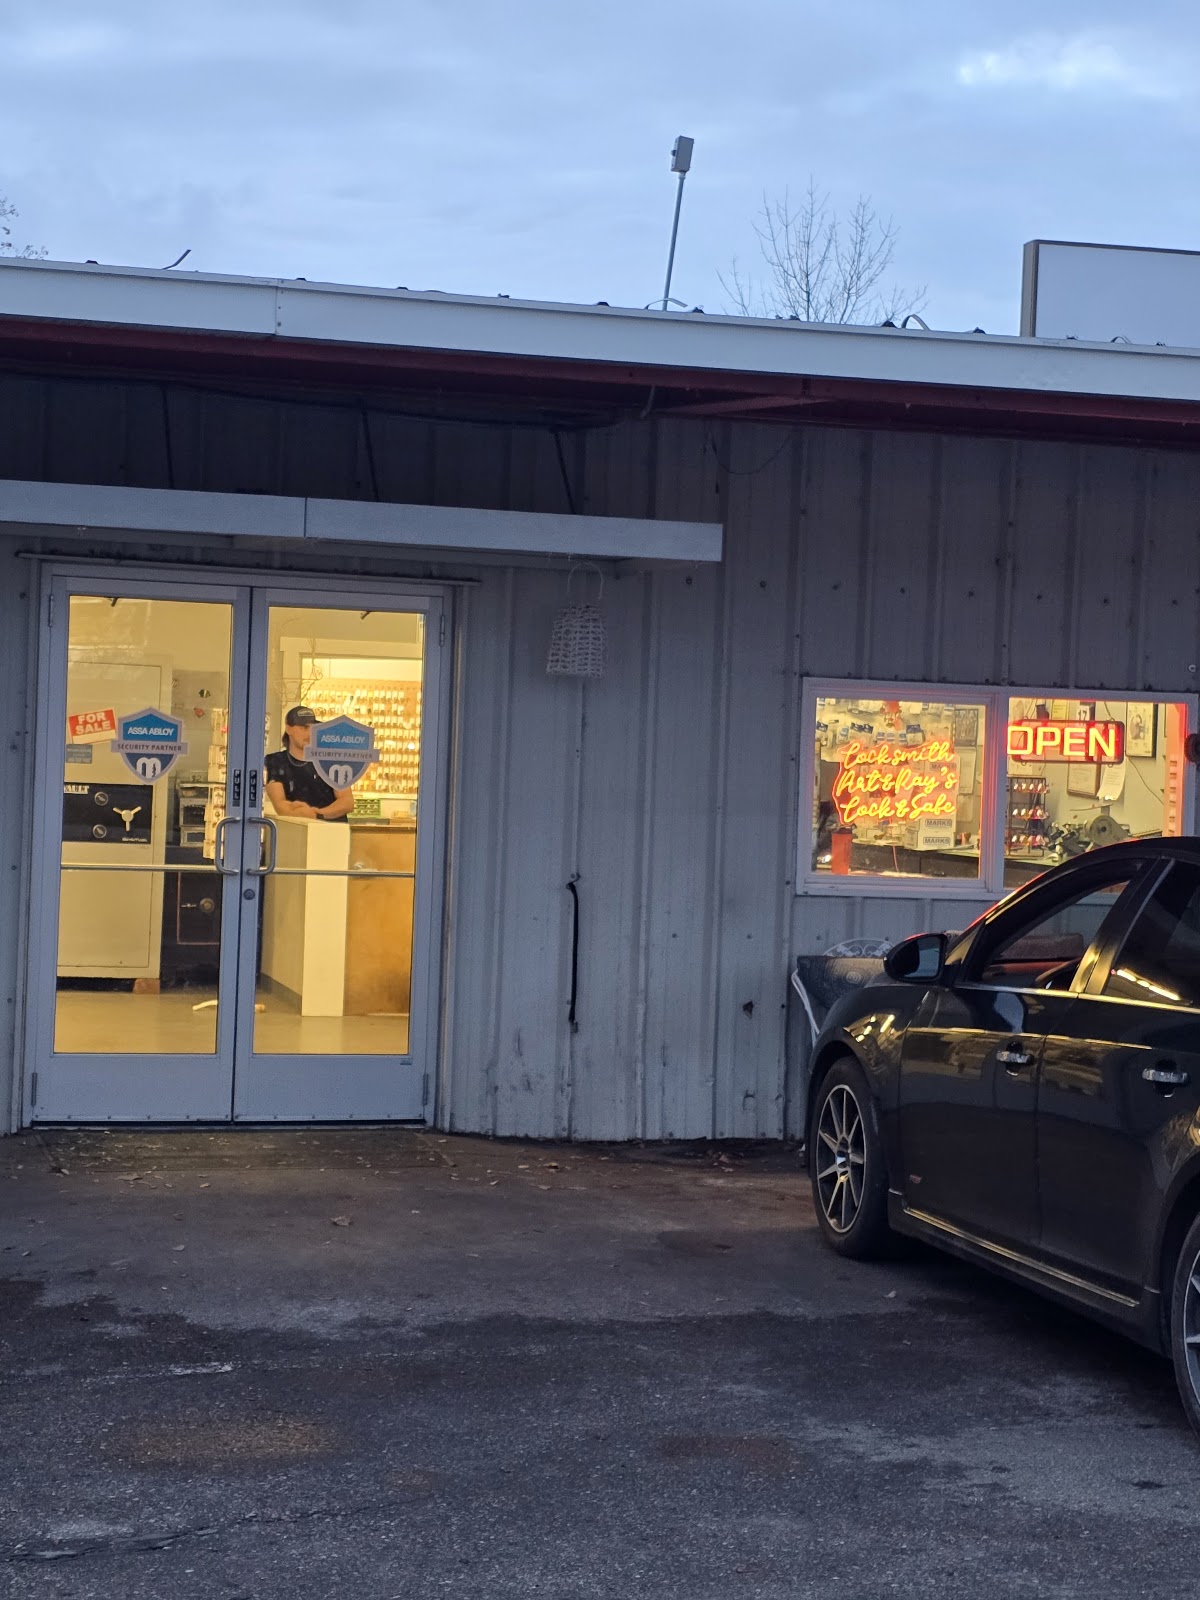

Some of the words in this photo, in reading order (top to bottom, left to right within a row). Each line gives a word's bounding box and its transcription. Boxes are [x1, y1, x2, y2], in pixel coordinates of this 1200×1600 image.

[78, 711, 106, 724] FOR
[75, 721, 112, 735] SALE
[127, 727, 148, 736] ASSA
[149, 728, 175, 737] ABLOY
[321, 735, 340, 743] ASSA
[341, 735, 366, 744] ABLOY
[1006, 725, 1116, 757] OPEN
[117, 743, 150, 751] SECURITY
[151, 744, 182, 752] PARTNER
[343, 752, 373, 760] PARTNER
[836, 769, 881, 797] Art
[894, 767, 958, 795] Ray's
[840, 796, 895, 823] Lock
[908, 792, 956, 819] Safe
[926, 819, 952, 827] MARKS
